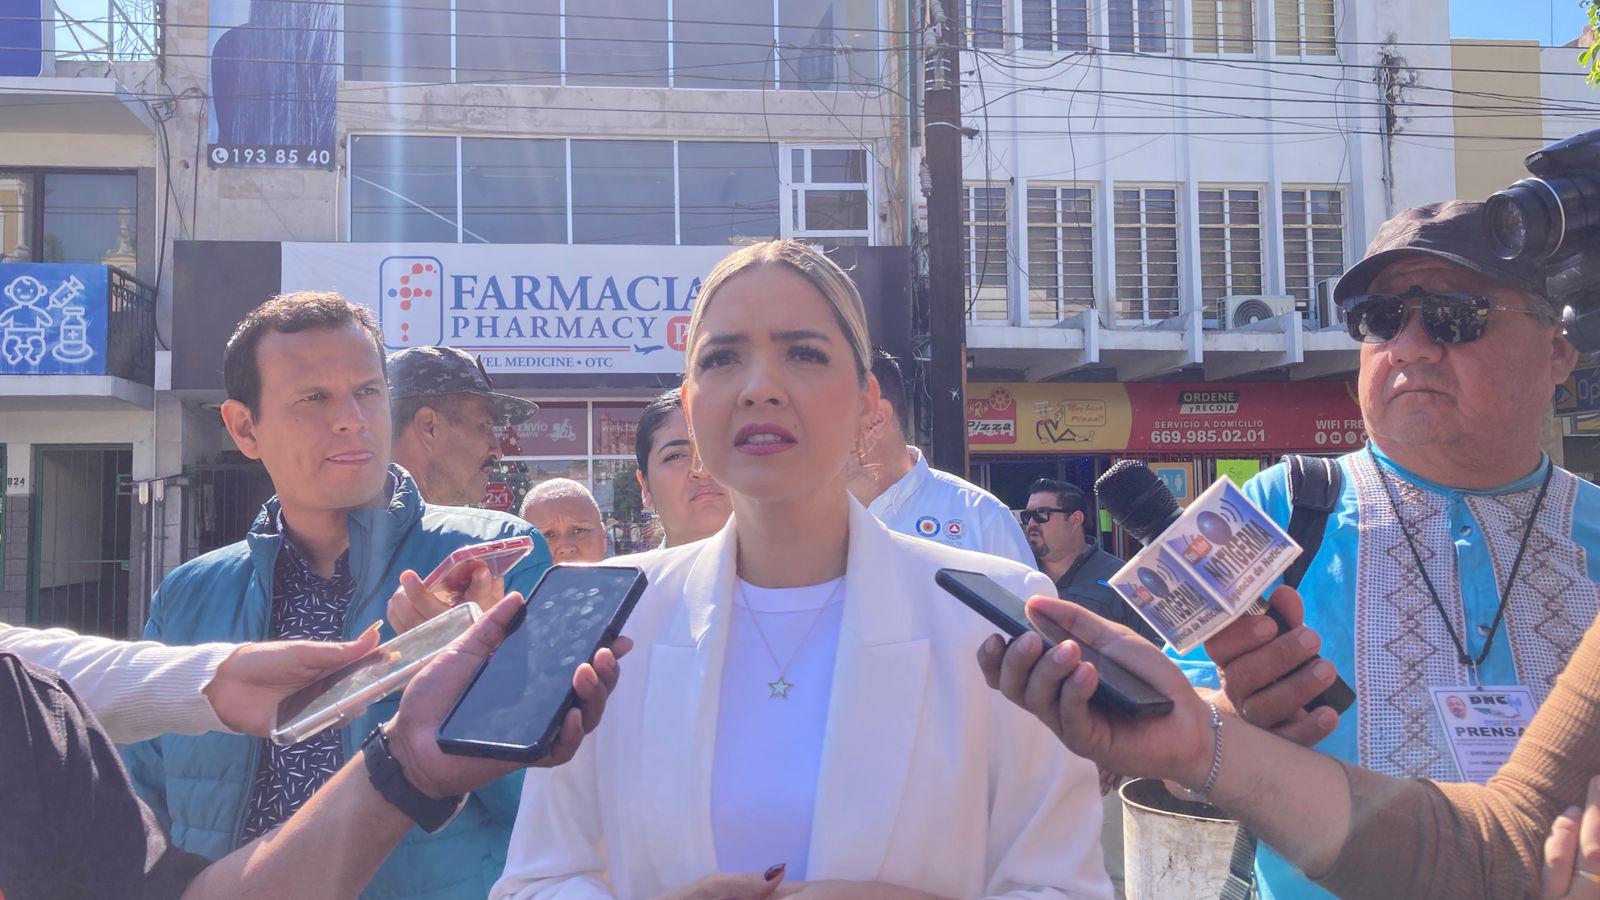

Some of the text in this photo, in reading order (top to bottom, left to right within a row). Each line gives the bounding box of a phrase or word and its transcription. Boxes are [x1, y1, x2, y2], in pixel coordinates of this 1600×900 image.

[233, 148, 330, 164] 193 85 40
[451, 316, 657, 339] PHARMACY
[505, 357, 574, 368] MEDICINE
[585, 357, 613, 368] OTC
[1183, 392, 1235, 402] ORDENE
[968, 420, 1012, 432] Pizza
[1154, 420, 1200, 429] SERVICIO
[1213, 419, 1264, 428] DOMICILIO
[1315, 419, 1365, 430] WIFI FRE
[1150, 429, 1266, 444] 669.985.02.01
[8, 477, 25, 486] 824
[486, 492, 508, 504] 2x1
[1203, 519, 1274, 588] NOTIGERMA
[1253, 565, 1264, 577] de
[1148, 580, 1209, 632] NOTIGERMA
[1455, 727, 1525, 737] PRENSA
